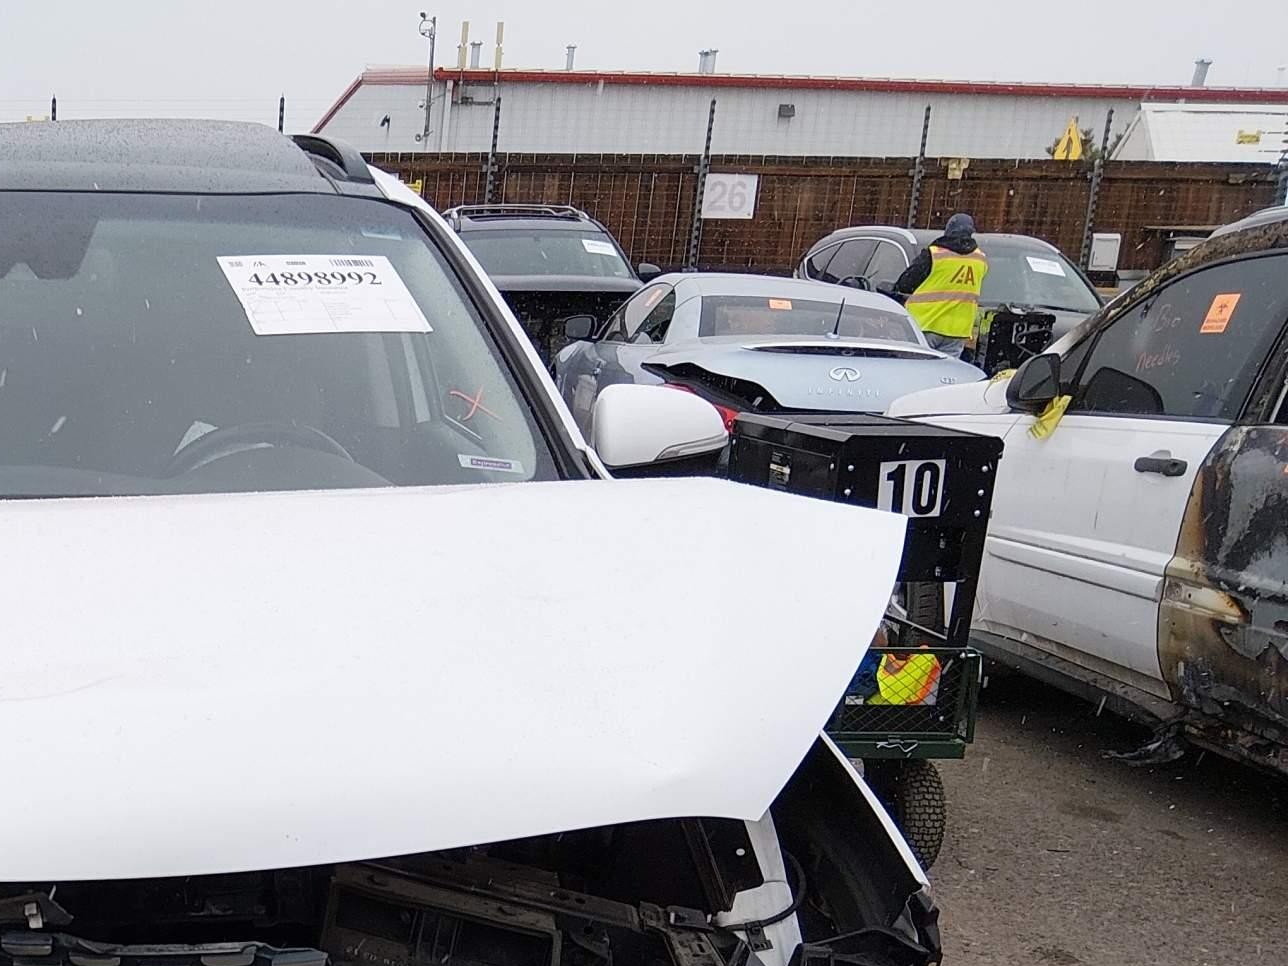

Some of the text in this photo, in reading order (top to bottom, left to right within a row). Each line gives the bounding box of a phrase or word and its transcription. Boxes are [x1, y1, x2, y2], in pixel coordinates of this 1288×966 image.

[707, 179, 747, 212] 26
[248, 271, 382, 286] 44898992
[807, 386, 880, 398] INFINITI
[886, 462, 940, 516] 10
